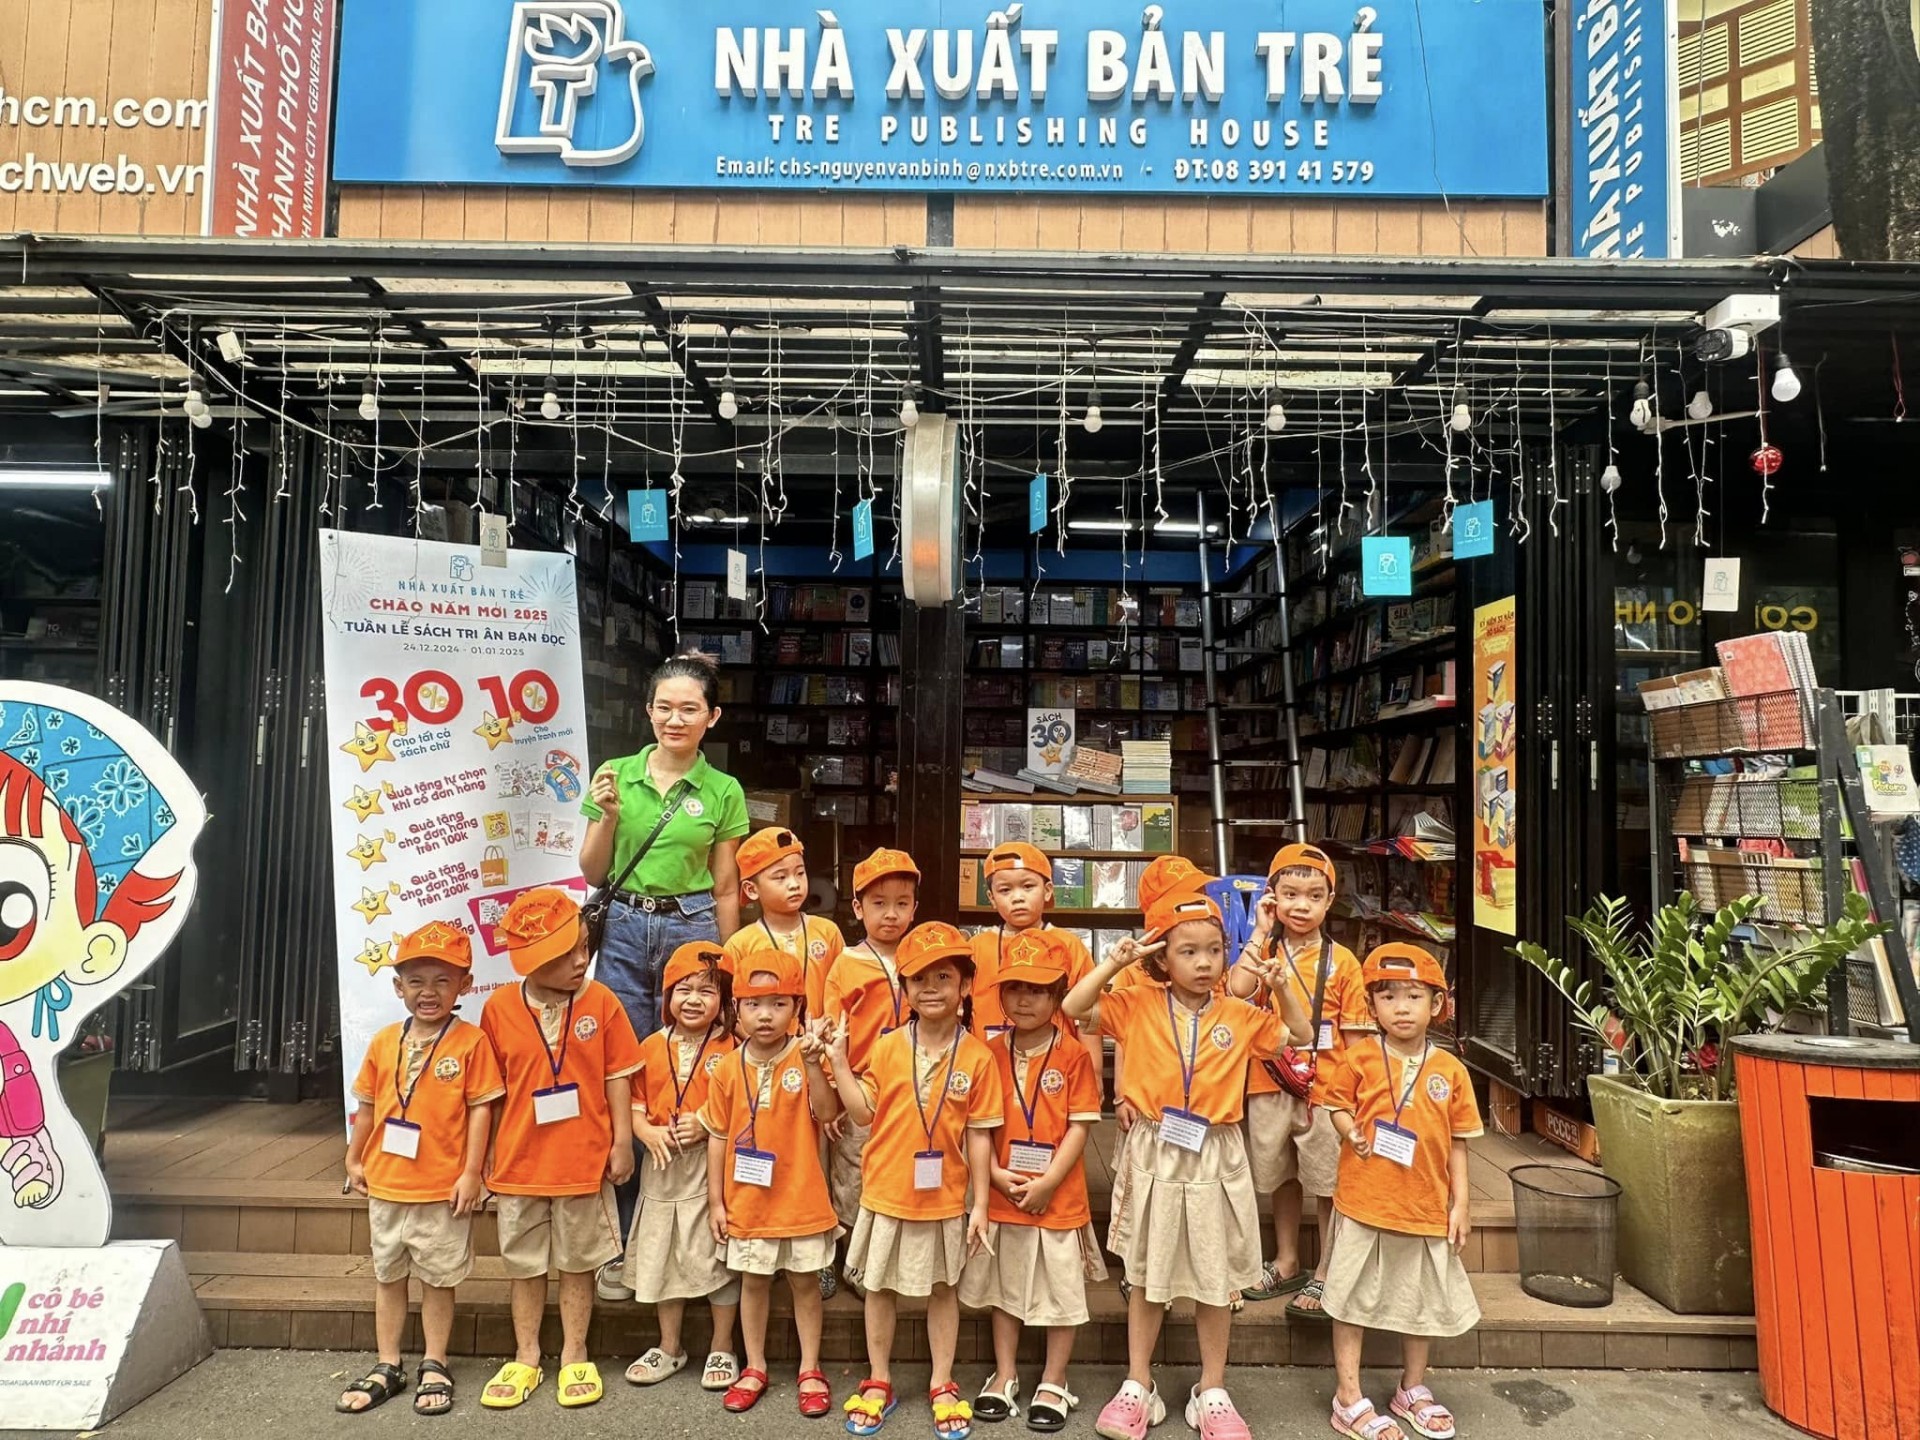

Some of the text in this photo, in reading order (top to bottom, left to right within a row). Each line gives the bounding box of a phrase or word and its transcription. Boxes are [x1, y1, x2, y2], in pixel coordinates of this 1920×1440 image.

[715, 3, 1383, 104] NHÀ XUẤT BẢN TRẺ
[272, 31, 301, 133] PHỐ
[307, 28, 322, 114] GENERAL
[234, 43, 266, 160] XUẤT
[305, 113, 317, 159] CITY
[768, 114, 1329, 148] TRE PUBLISHING HOUSE
[1578, 51, 1620, 203] XUẤT
[716, 155, 775, 178] Email:
[1175, 158, 1239, 181] ĐT:08
[1249, 159, 1286, 181] 391
[1298, 160, 1321, 181] 41
[1332, 161, 1374, 182] 579
[302, 160, 315, 217] MINH
[398, 580, 426, 593] NHÀ
[431, 582, 465, 595] XUẤT
[369, 597, 424, 613] CHÀO
[430, 600, 470, 616] NĂM
[514, 608, 548, 621] 2025
[344, 618, 566, 647] TUẦN LỄ SÁCH TRI ÂN BẠN ĐỌC
[403, 642, 460, 656] 24.12.2024
[533, 726, 549, 734] Cho
[1036, 712, 1062, 724] SÁCH
[392, 727, 451, 748] Cho tất cả
[399, 740, 451, 758] sách chữ
[414, 779, 443, 796] tặng
[443, 774, 457, 787] tự
[458, 767, 487, 780] chọn
[391, 779, 486, 812] khi có đơn hàng
[398, 818, 479, 849] cho đơn hàng
[408, 811, 465, 834] Quà tặng
[416, 831, 469, 856] trên 100k
[399, 888, 423, 902] cho
[425, 881, 449, 893] đơn
[448, 868, 479, 884] hàng
[410, 861, 466, 886] Quà tặng
[417, 881, 470, 908] trên 200k
[28, 1286, 104, 1309] cô bé
[16, 1311, 74, 1335] nhí
[4, 1335, 107, 1362] nhảnh
